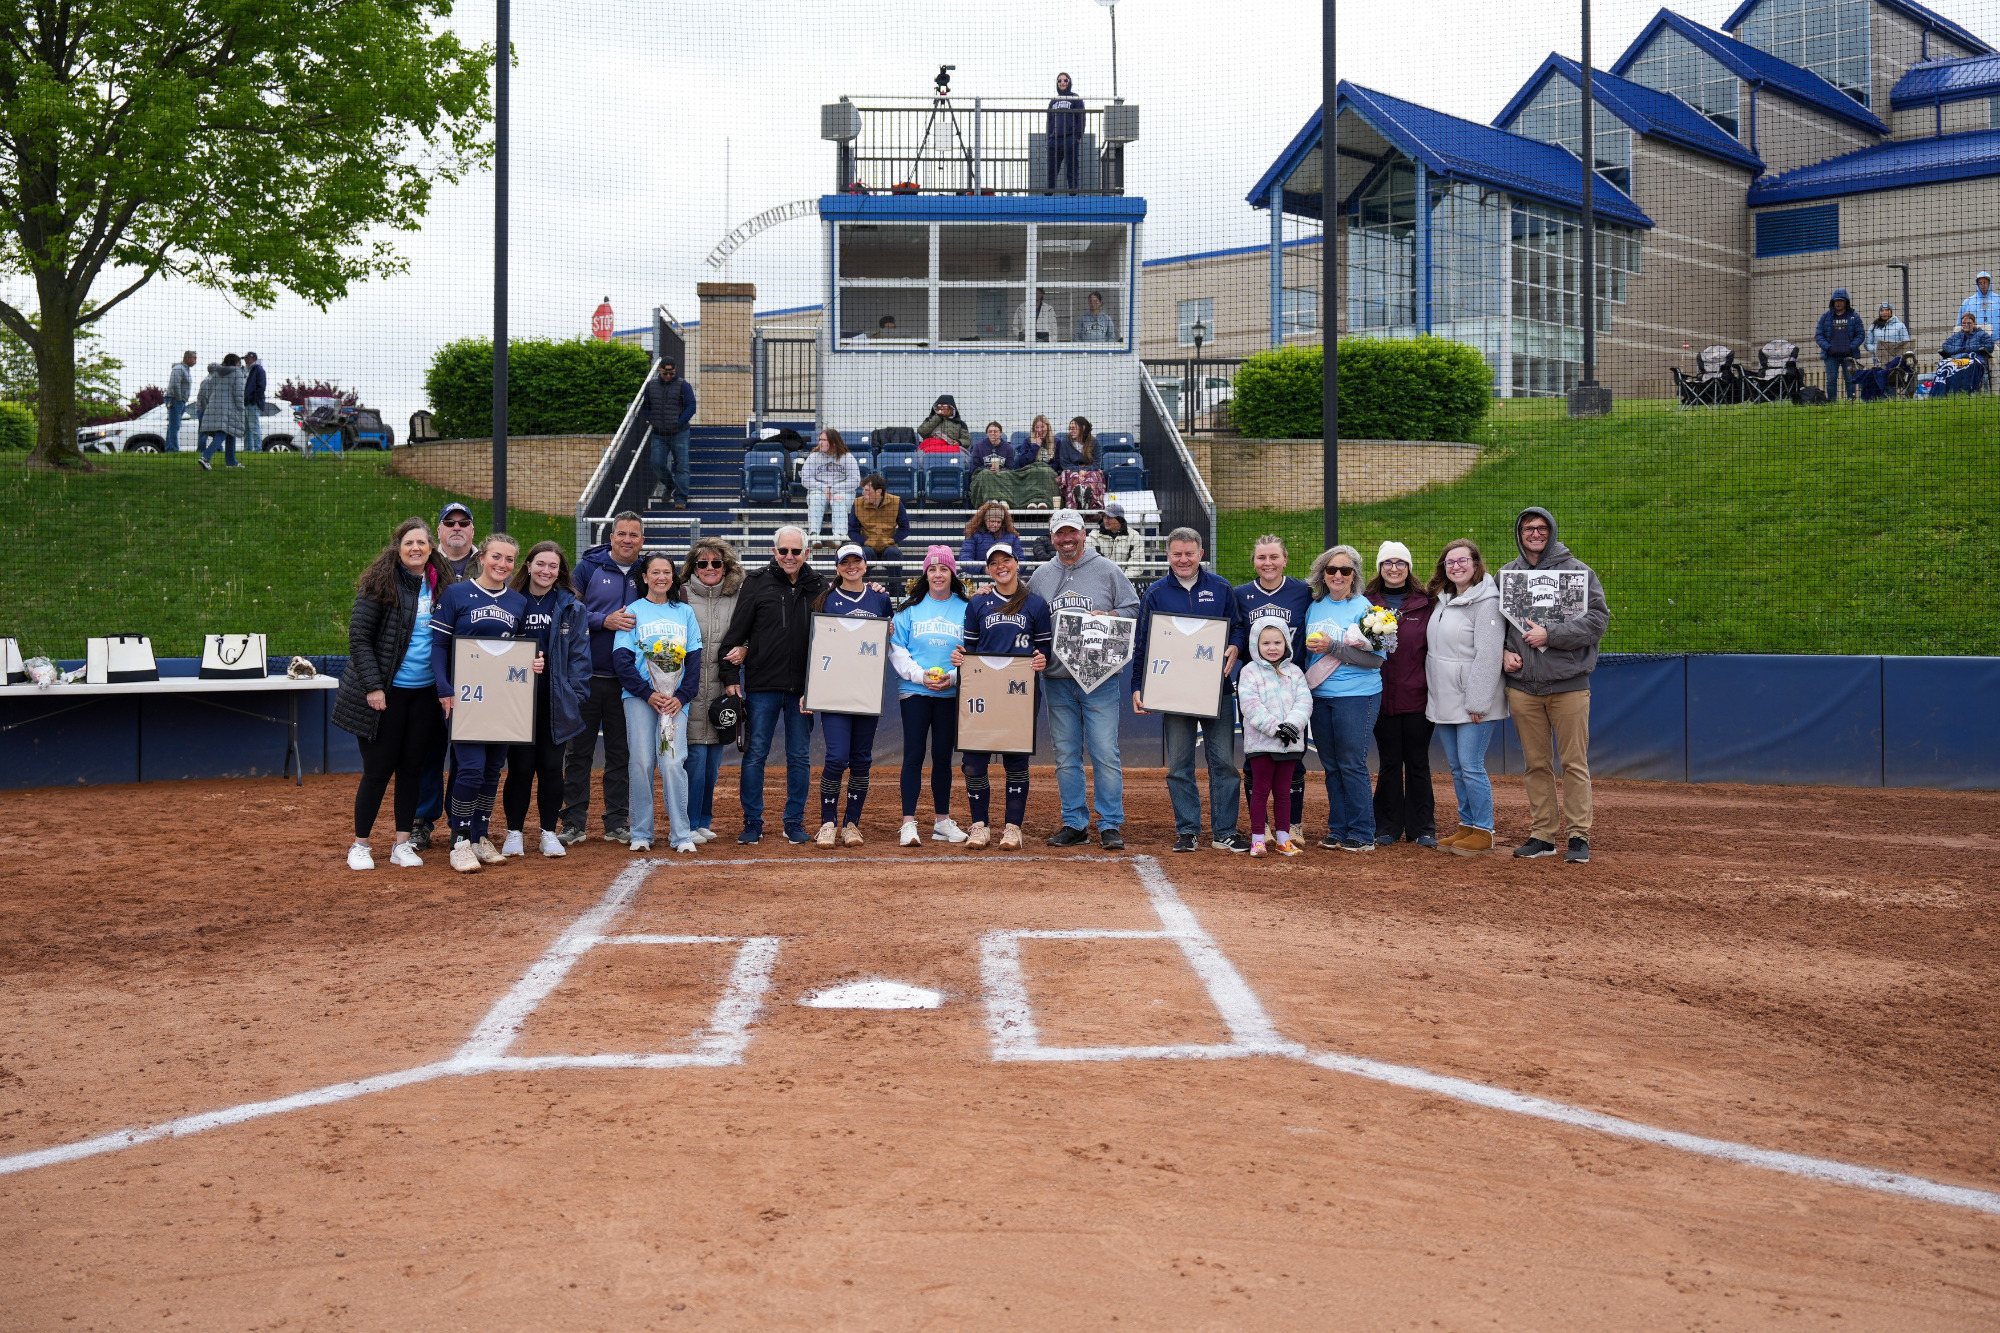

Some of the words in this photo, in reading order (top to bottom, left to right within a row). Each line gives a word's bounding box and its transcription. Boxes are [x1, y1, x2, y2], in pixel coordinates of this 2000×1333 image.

[593, 313, 613, 331] STOP
[1048, 599, 1063, 614] THE
[1065, 597, 1090, 610] MOUNT
[472, 609, 488, 621] THE
[987, 614, 1000, 625] THE
[1002, 614, 1024, 626] MOUNT
[1250, 610, 1263, 620] THE
[1265, 609, 1289, 620] MOUNT
[640, 625, 657, 638] THE
[914, 623, 931, 637] THE
[1014, 633, 1030, 648] 16
[858, 640, 878, 657] M
[1193, 644, 1215, 661] M
[822, 656, 832, 671] 7
[1152, 659, 1171, 675] 17
[506, 666, 528, 683] M
[461, 684, 483, 702] 24
[1007, 679, 1028, 695] M
[967, 698, 985, 713] 16
